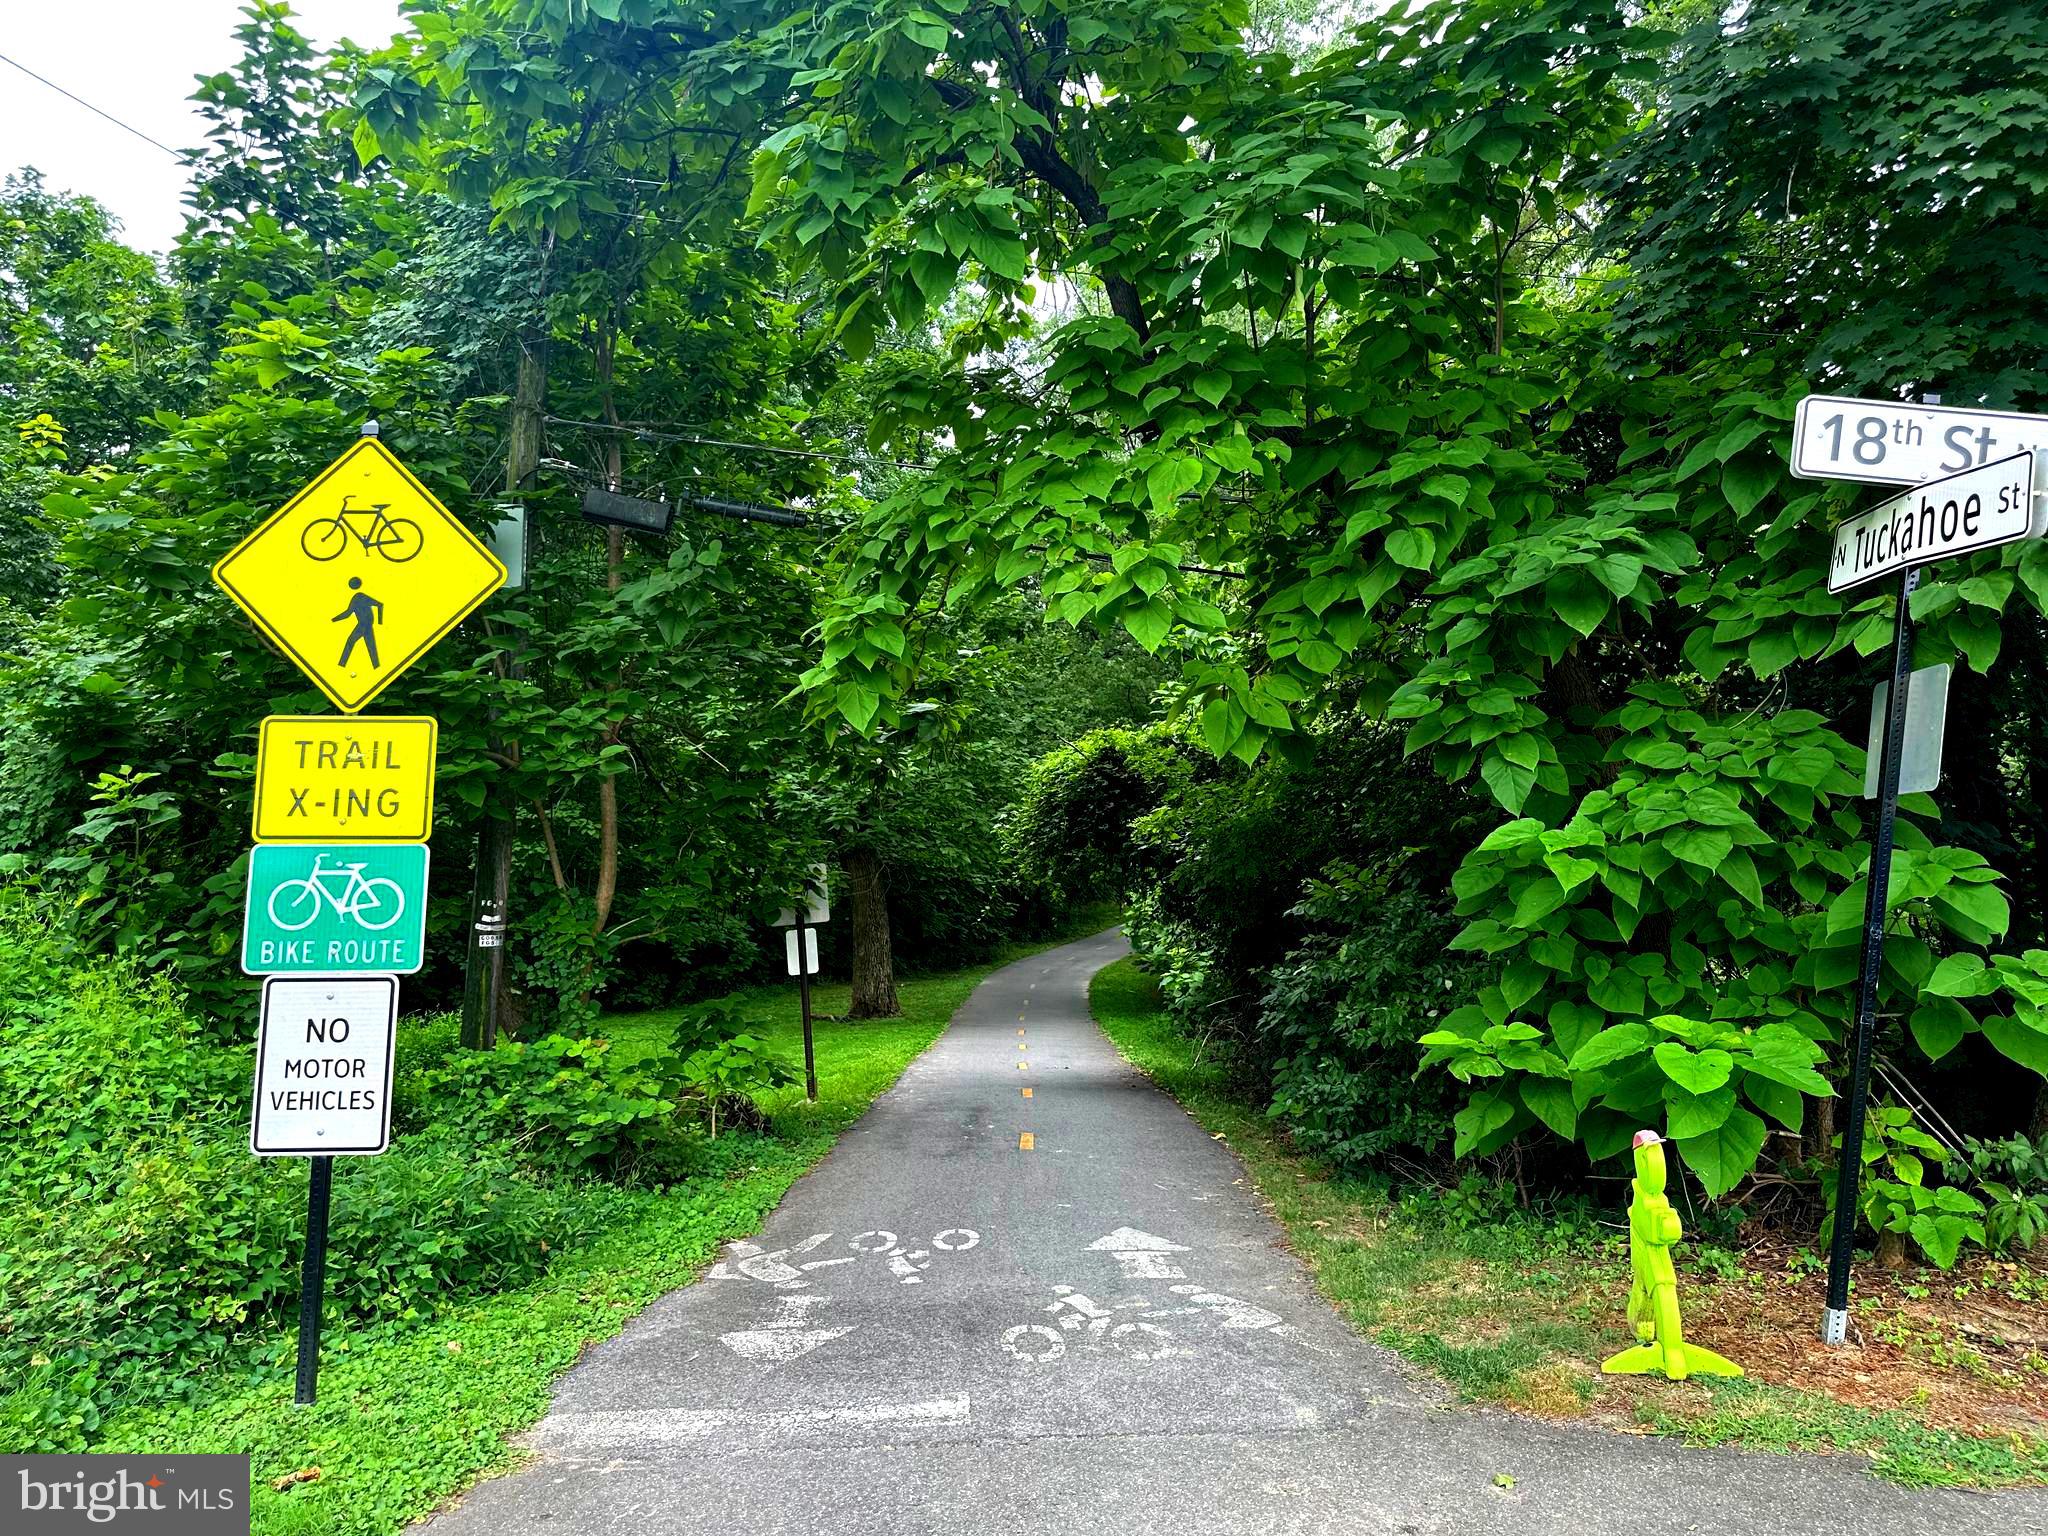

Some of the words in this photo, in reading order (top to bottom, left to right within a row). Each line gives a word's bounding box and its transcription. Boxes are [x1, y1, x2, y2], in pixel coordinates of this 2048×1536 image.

[1822, 414, 1923, 466] 18th
[1939, 425, 1997, 473] St
[1836, 543, 1847, 569] N
[1854, 492, 1981, 573] Tuckahoe
[1997, 482, 2020, 514] St
[294, 740, 401, 769] TRAIL
[287, 788, 401, 817] X-ING
[260, 940, 315, 964] BIKE
[327, 939, 406, 964] ROUTE
[306, 1018, 350, 1043] NO
[284, 1058, 366, 1079] MOTOR
[270, 1090, 375, 1111] VEHICLES
